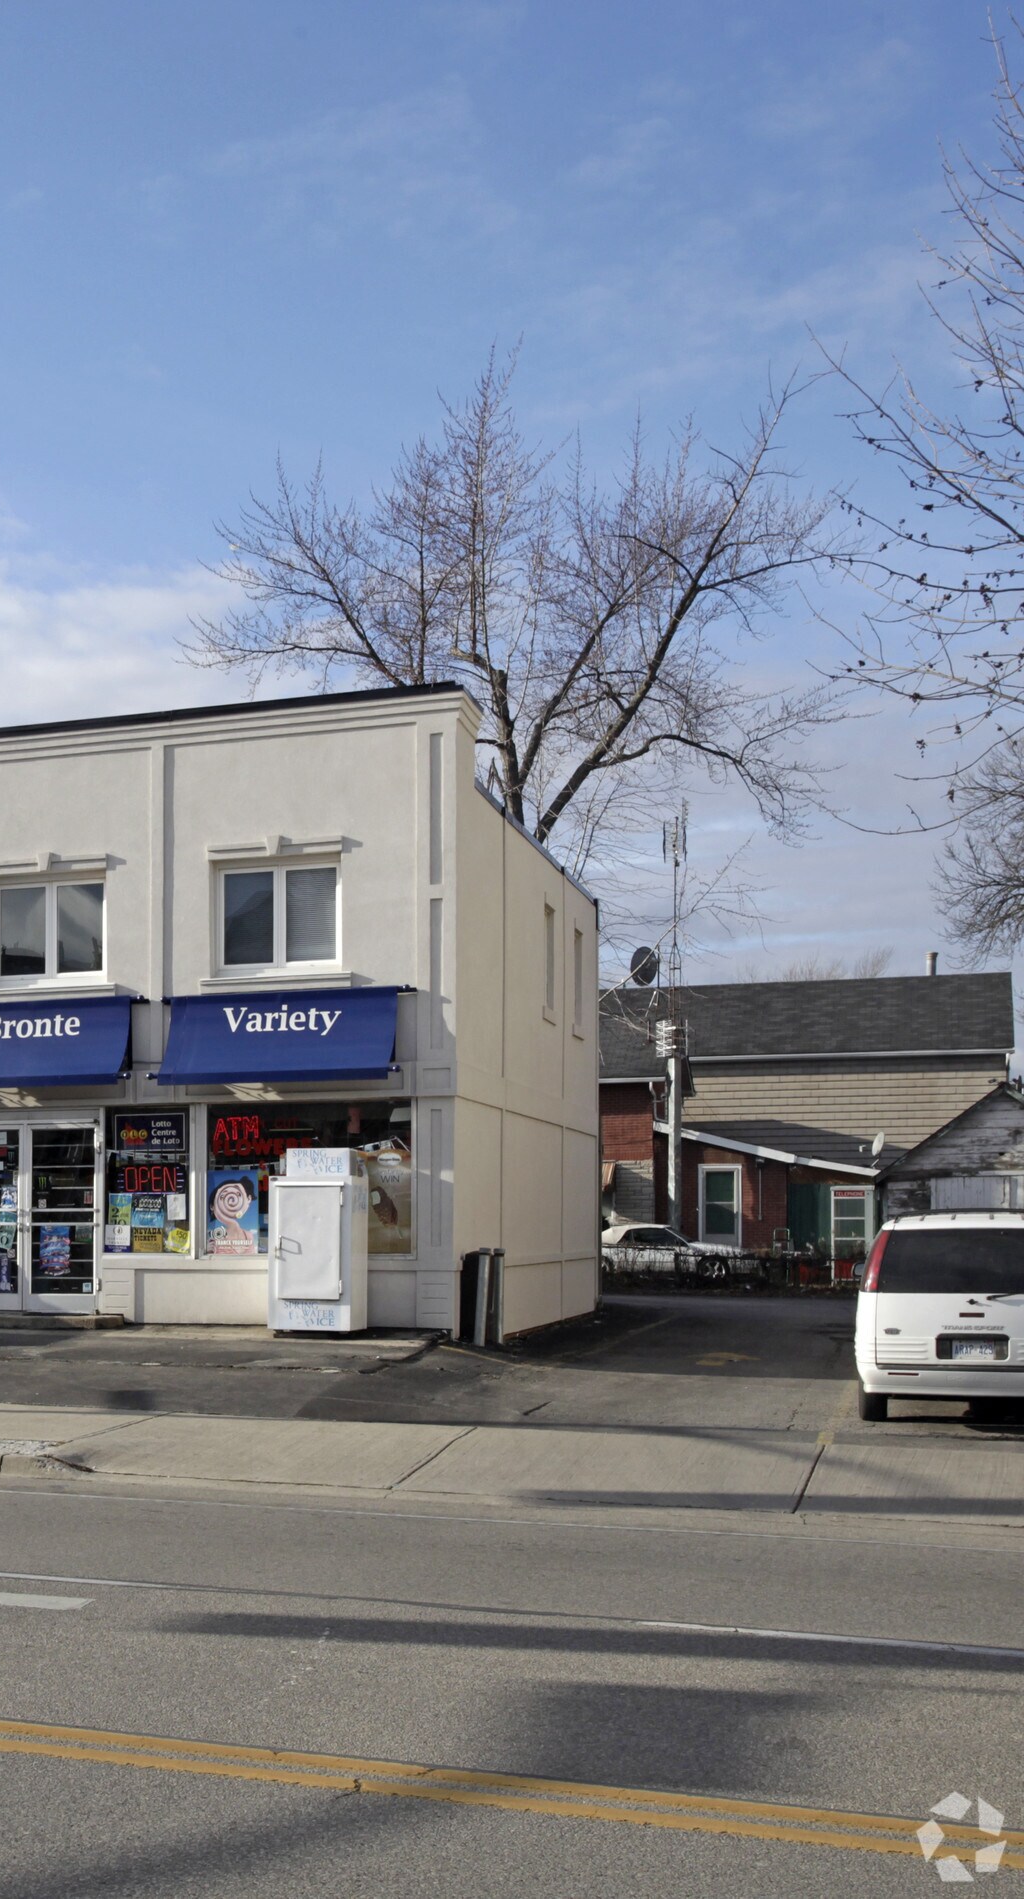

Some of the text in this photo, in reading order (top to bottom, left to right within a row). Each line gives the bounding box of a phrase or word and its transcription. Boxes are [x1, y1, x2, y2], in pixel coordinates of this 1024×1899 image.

[223, 1004, 342, 1036] Variety
[151, 1120, 172, 1128] Lotto
[214, 1115, 260, 1141] ATM
[151, 1129, 176, 1137] Centre
[163, 1137, 180, 1145] Loto
[292, 1149, 326, 1158] SPRING
[311, 1157, 343, 1165] WATER
[325, 1165, 343, 1174] ICE
[124, 1166, 176, 1193] OPEN
[380, 1175, 400, 1183] WIN
[283, 1301, 319, 1309] SPRING
[304, 1309, 335, 1318] WATER
[317, 1318, 335, 1327] ICE
